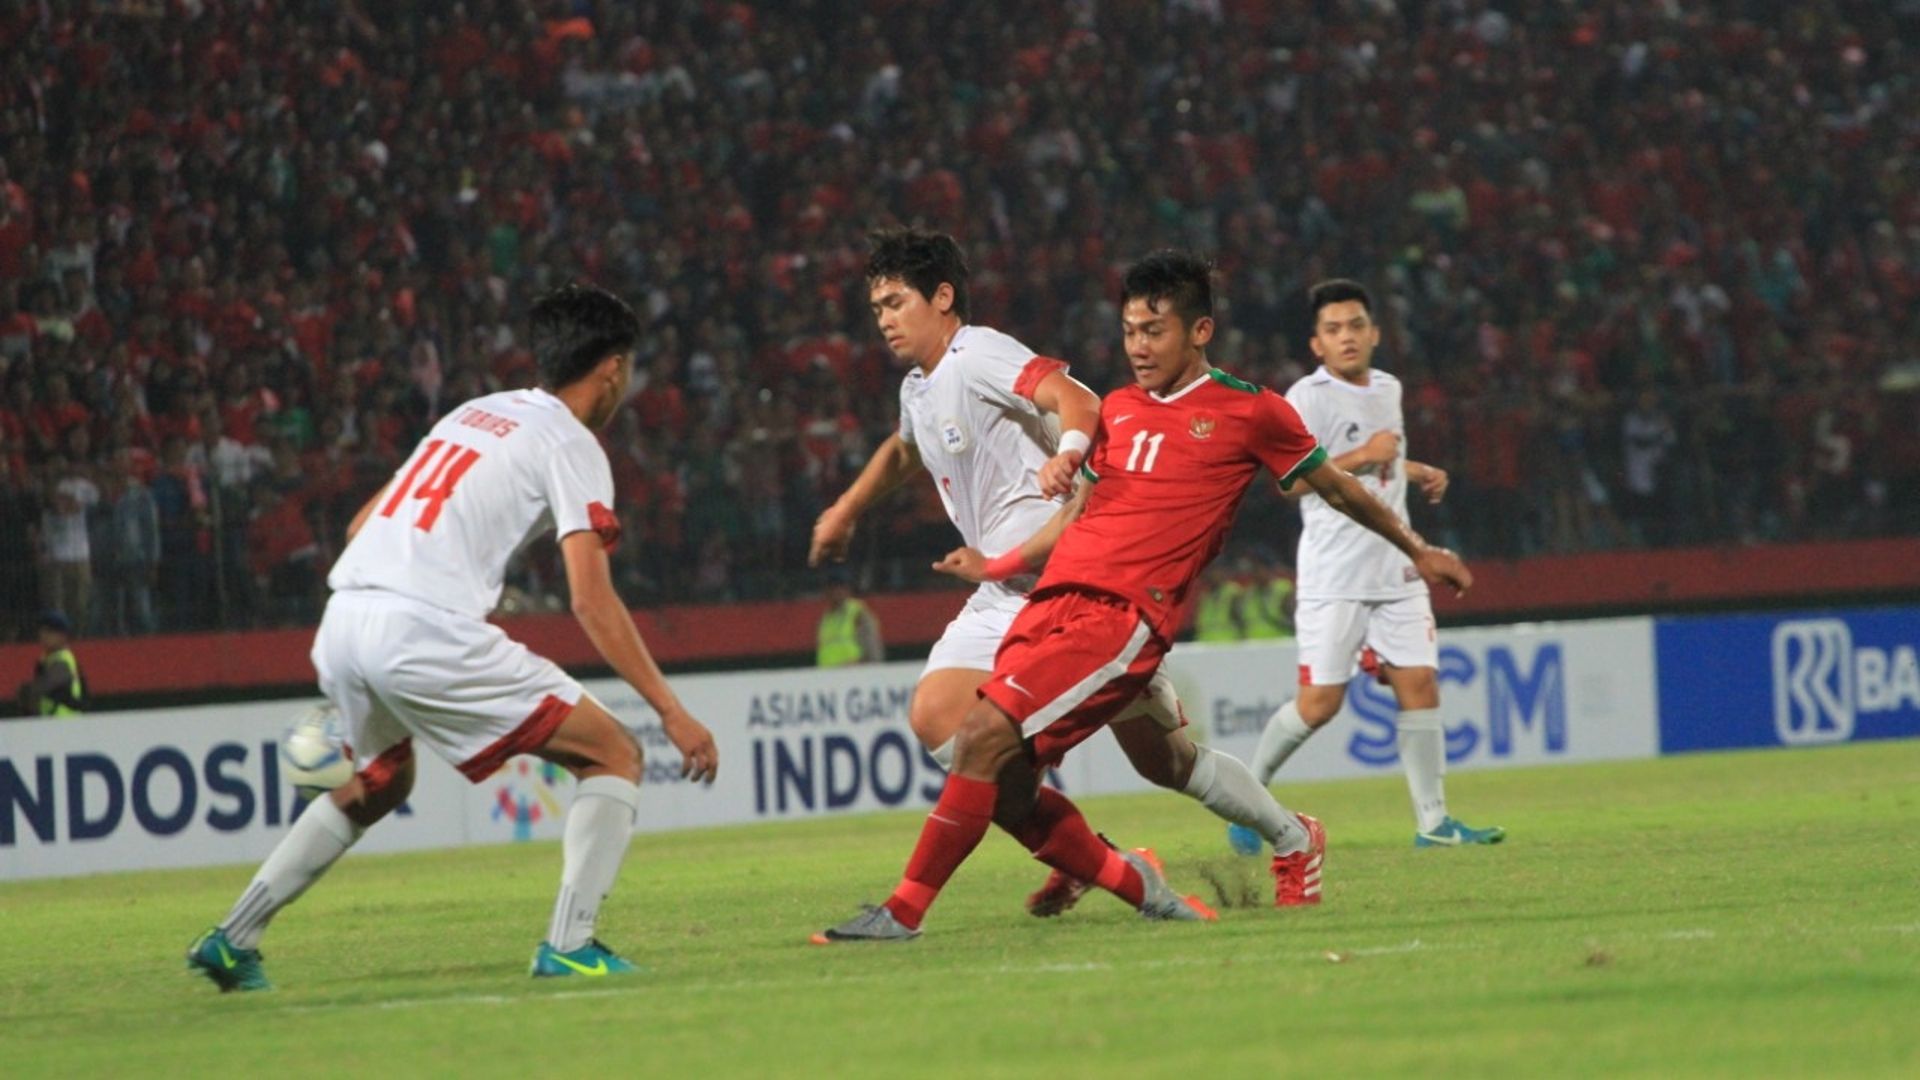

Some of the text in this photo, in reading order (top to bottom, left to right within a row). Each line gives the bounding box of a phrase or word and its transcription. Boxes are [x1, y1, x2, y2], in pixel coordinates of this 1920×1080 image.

[379, 439, 481, 533] 14
[1125, 429, 1165, 473] 11
[748, 686, 914, 728] ASIAN GAM
[0, 740, 413, 845] NDOSI
[753, 729, 1065, 815] INDOS
